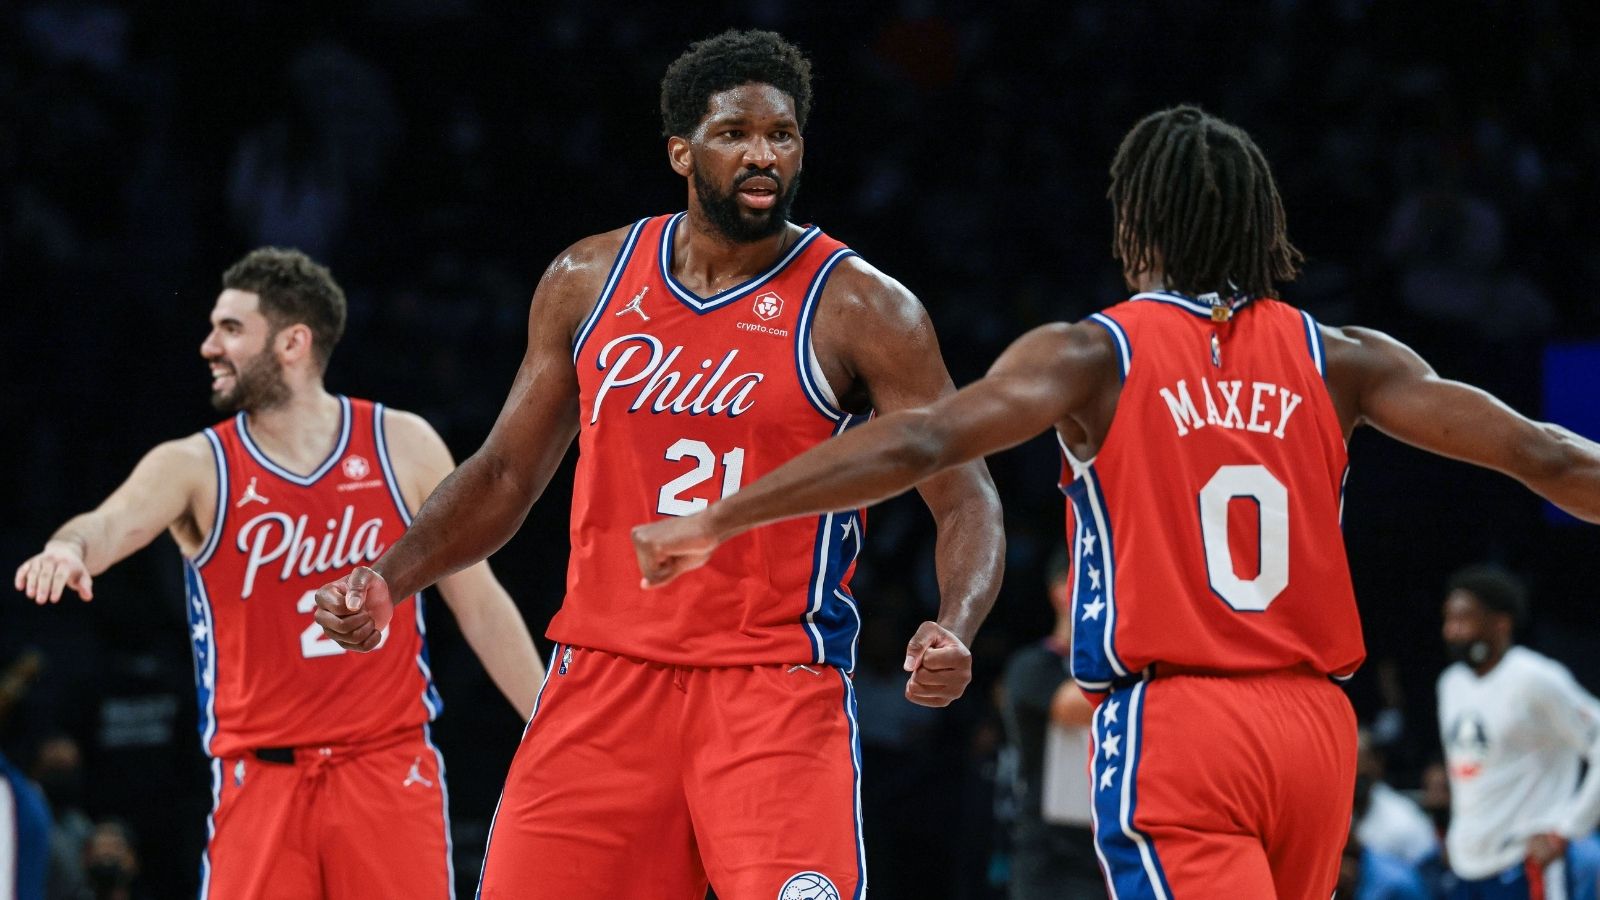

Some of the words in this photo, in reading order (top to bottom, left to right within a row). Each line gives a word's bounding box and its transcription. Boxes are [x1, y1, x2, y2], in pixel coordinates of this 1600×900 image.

[736, 321, 788, 336] crypto.com
[590, 333, 764, 425] Phila
[1159, 376, 1302, 439] MAXEY
[656, 438, 745, 517] 21
[237, 505, 385, 599] Phila
[1198, 464, 1290, 612] 0
[297, 589, 390, 658] 2
